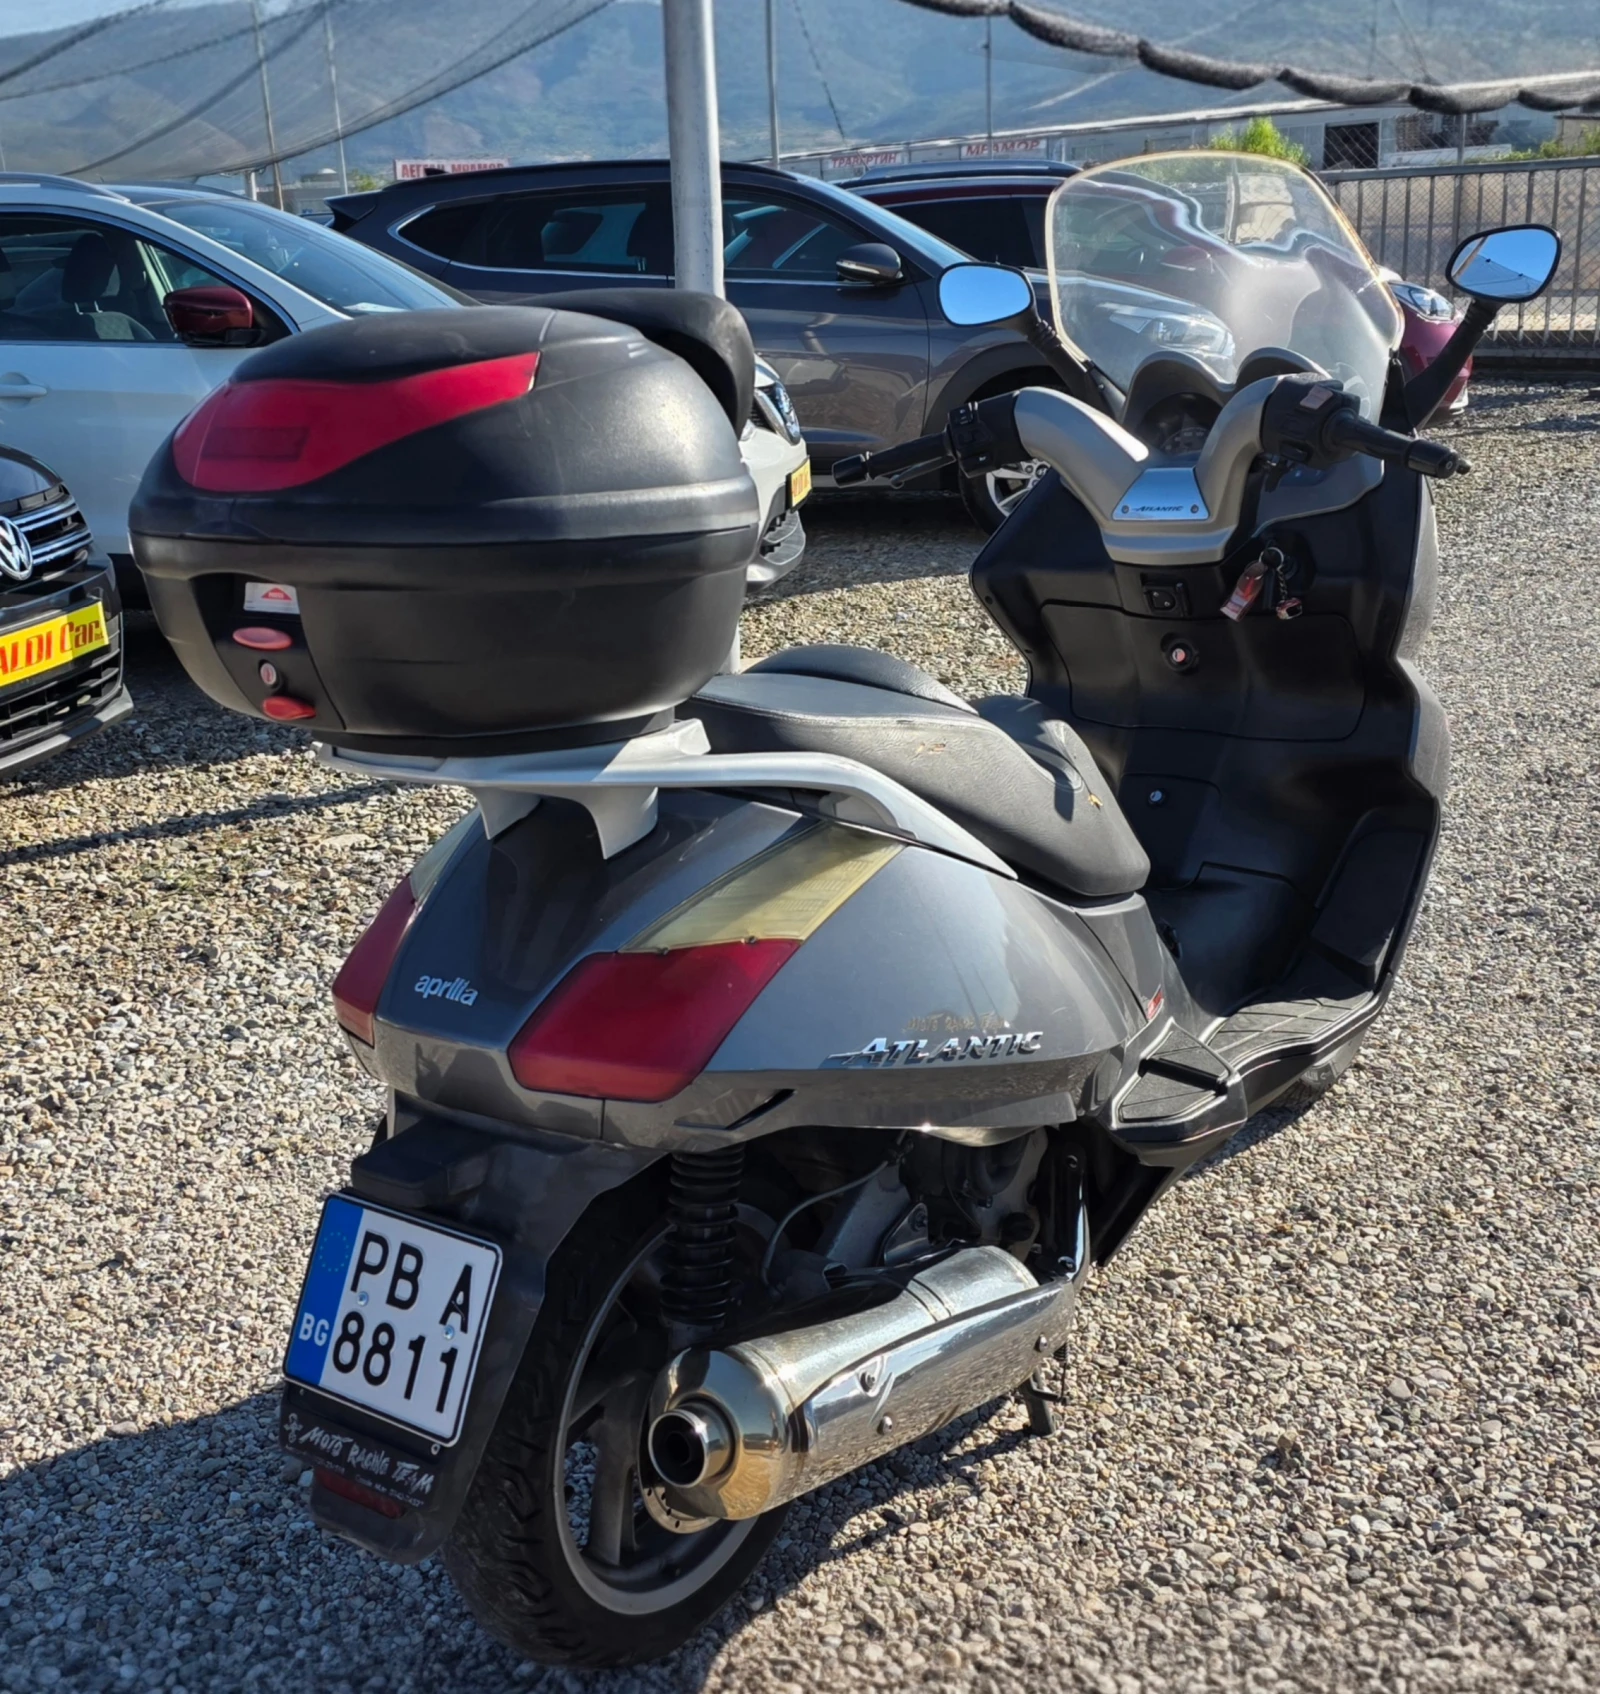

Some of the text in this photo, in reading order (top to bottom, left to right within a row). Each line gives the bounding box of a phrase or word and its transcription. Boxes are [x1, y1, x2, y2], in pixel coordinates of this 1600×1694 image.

[414, 975, 479, 1006] aprilia
[828, 1031, 1043, 1067] ATLANTIC
[350, 1230, 473, 1334] PB A
[299, 1312, 330, 1346] BG
[332, 1311, 458, 1413] 8811
[299, 1426, 354, 1457] MOTO
[347, 1442, 391, 1475] RACING
[391, 1461, 435, 1494] TEAM
